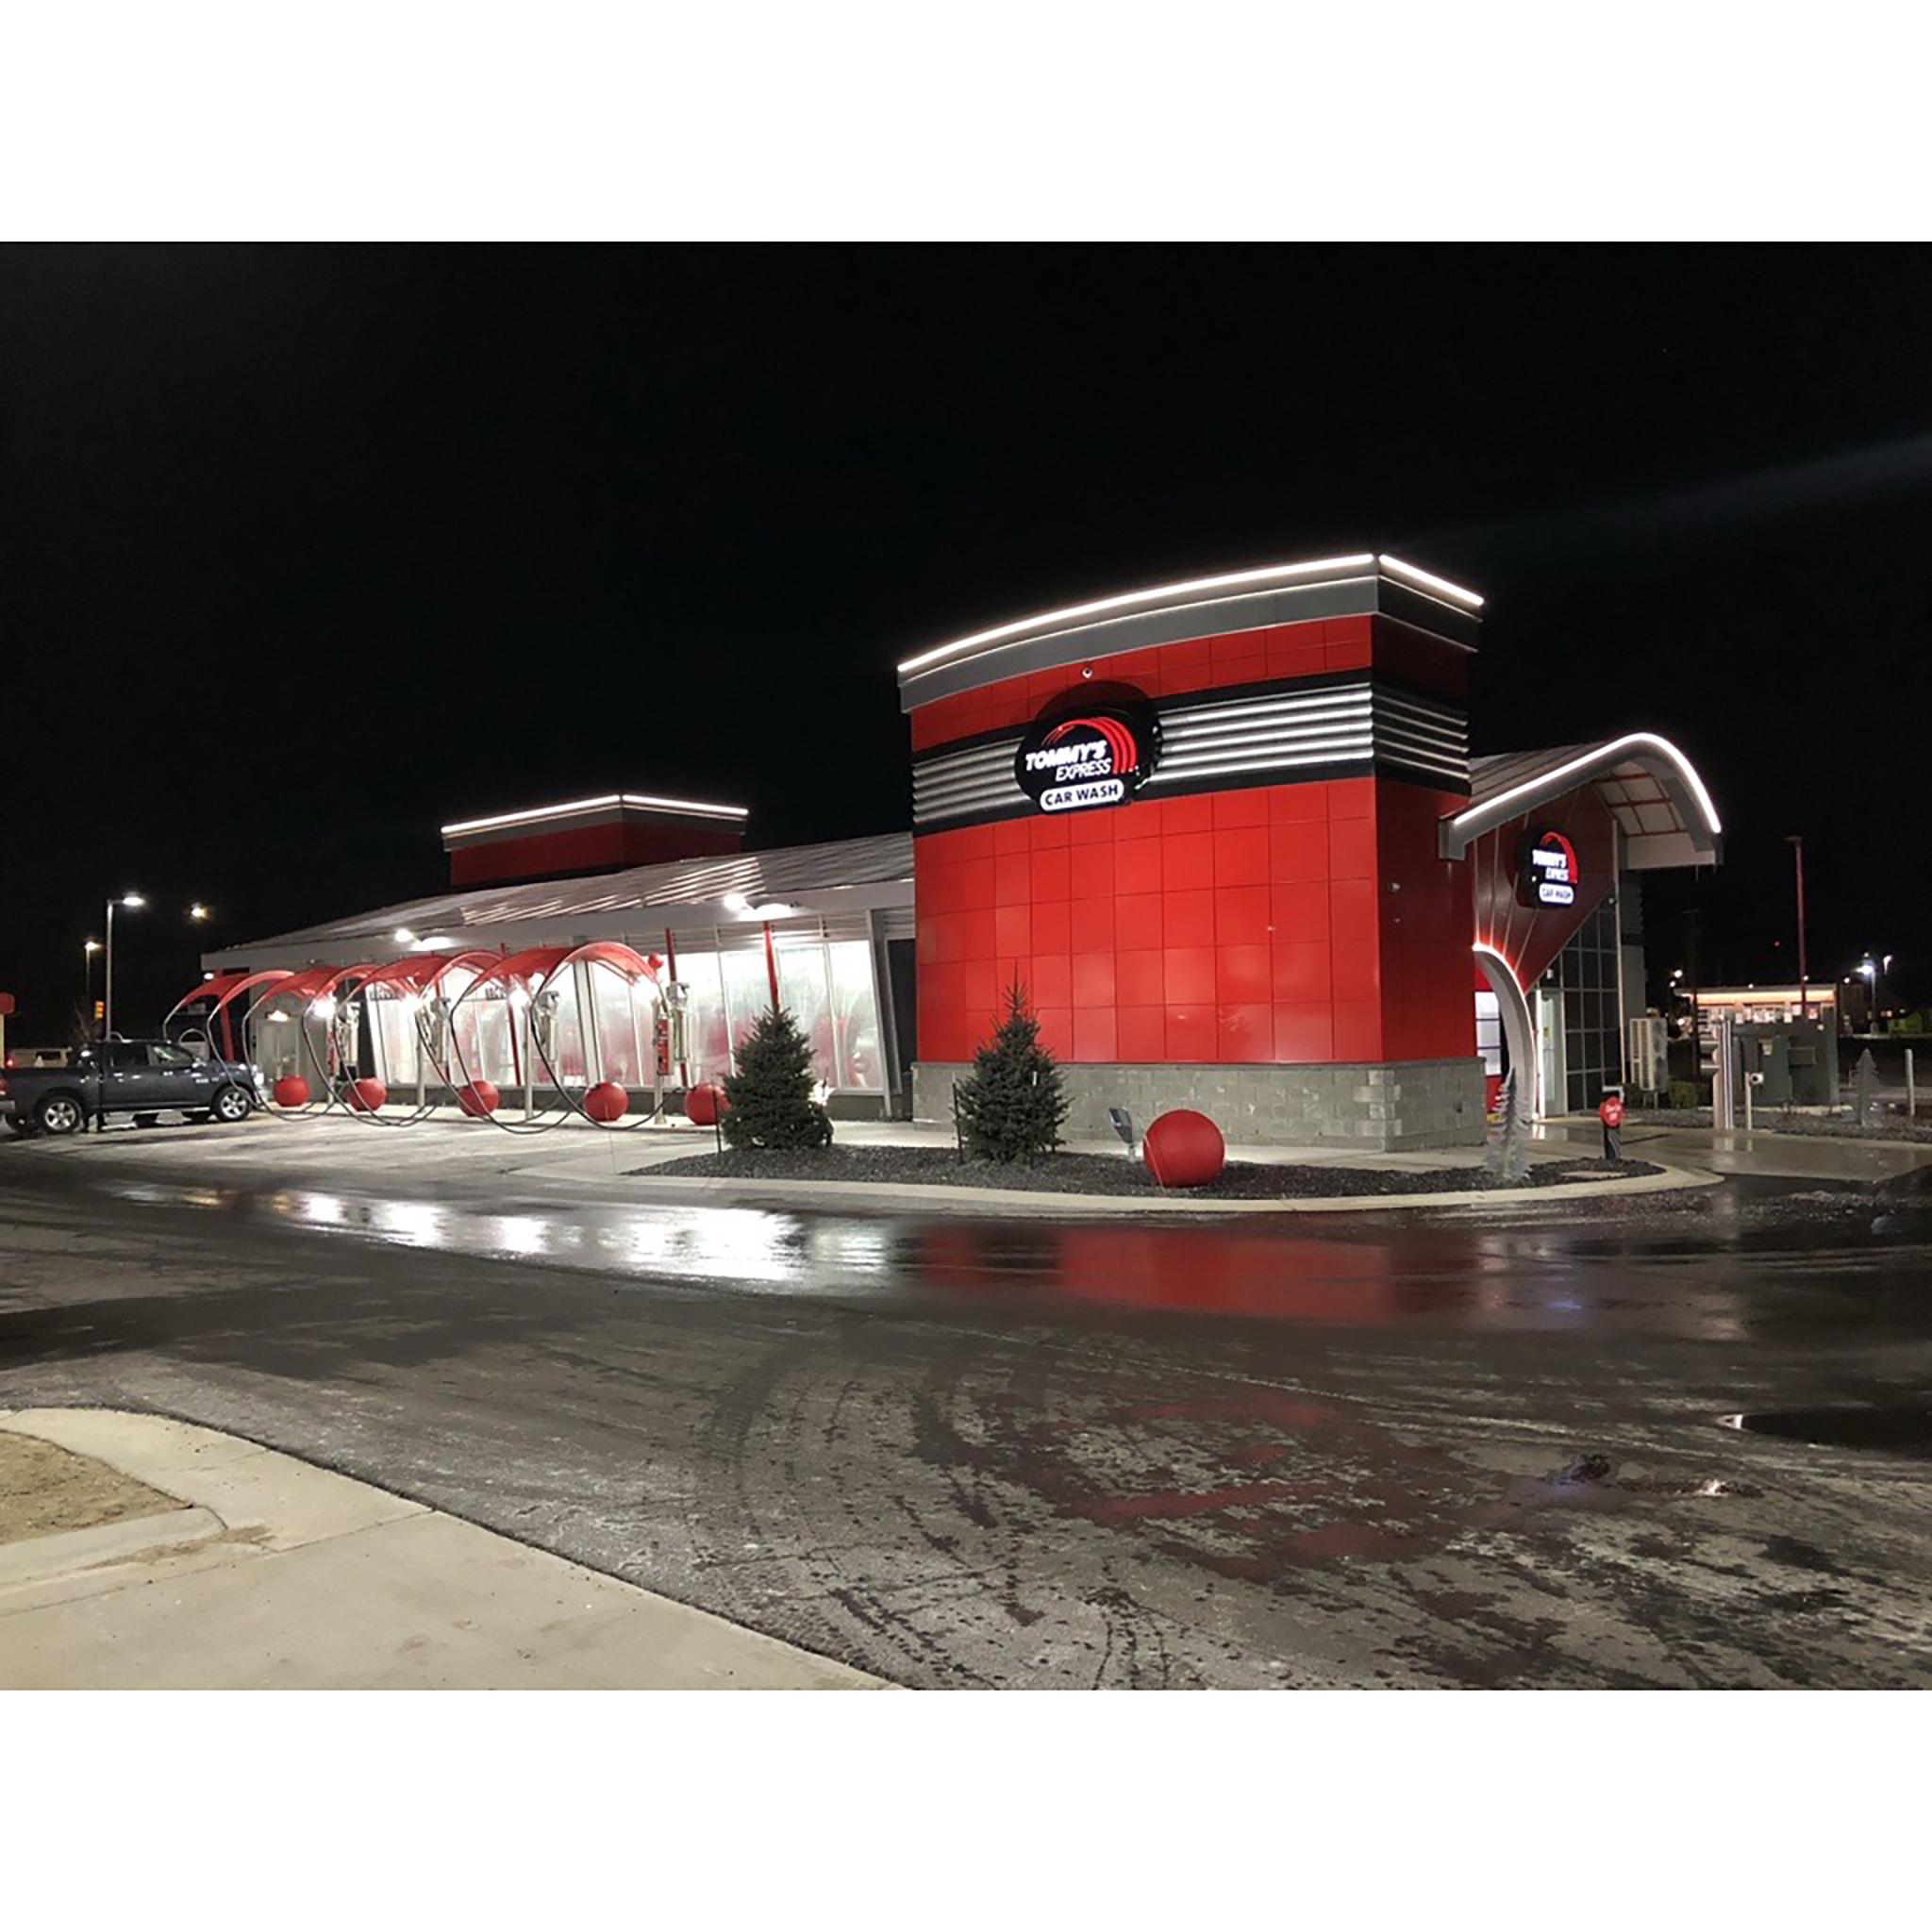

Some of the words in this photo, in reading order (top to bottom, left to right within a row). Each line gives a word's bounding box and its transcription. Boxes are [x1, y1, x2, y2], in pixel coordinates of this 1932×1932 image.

[1025, 740, 1108, 771] TOMMY'S
[1056, 758, 1111, 782] EXPRESS
[1044, 791, 1073, 806] CAR
[1076, 784, 1119, 801] WASH
